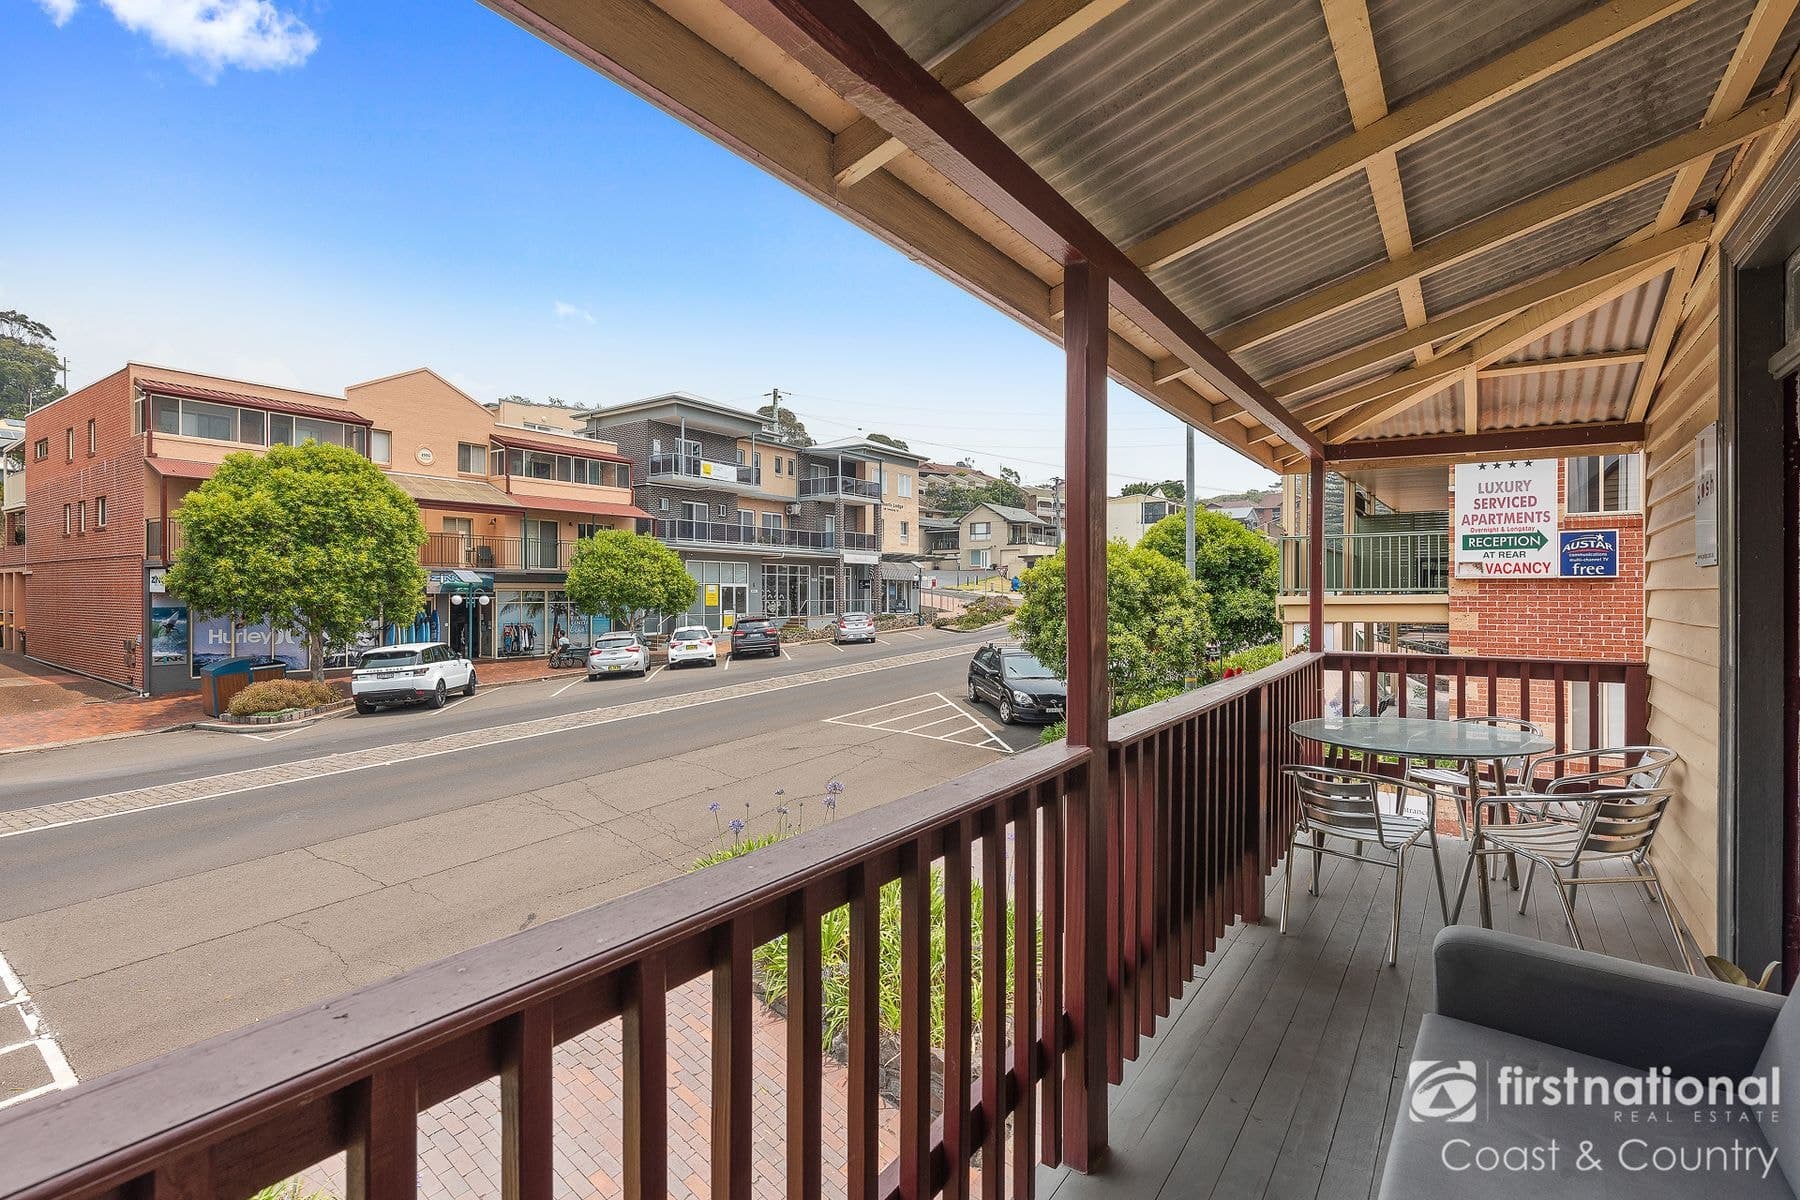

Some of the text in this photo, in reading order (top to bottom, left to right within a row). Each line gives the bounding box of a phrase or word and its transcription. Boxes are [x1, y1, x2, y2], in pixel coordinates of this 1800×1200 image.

[1478, 479, 1532, 494] LUXURY
[1473, 495, 1537, 510] SERVICED
[1461, 510, 1551, 526] APARTMENTS
[1468, 535, 1541, 548] RECEPTION
[1562, 540, 1614, 553] AUSTAR
[1483, 550, 1527, 559] AT REAR
[1485, 561, 1551, 575] VACANCY
[1571, 563, 1605, 575] free
[208, 629, 272, 645] Hurley
